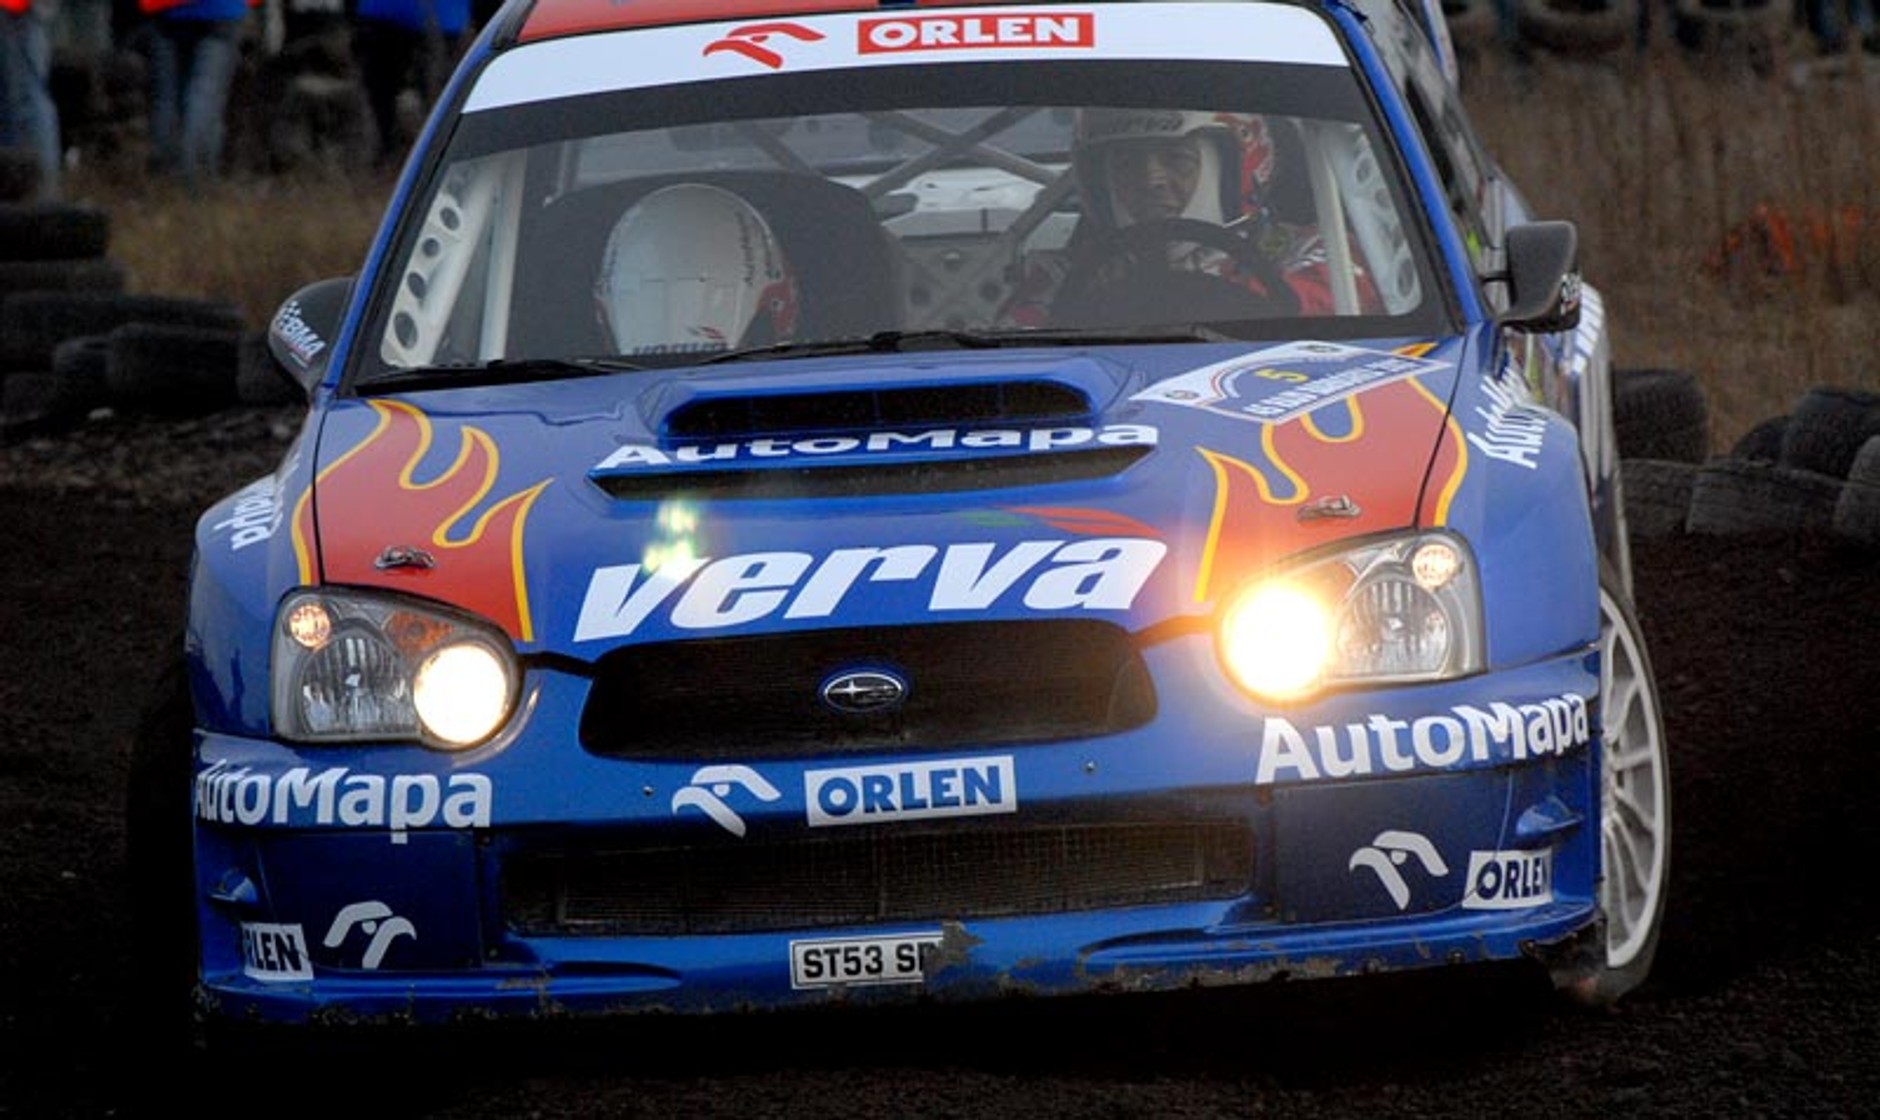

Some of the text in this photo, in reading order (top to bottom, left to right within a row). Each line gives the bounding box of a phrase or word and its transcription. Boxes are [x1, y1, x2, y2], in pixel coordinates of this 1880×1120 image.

[869, 17, 1080, 48] ORLEN
[1254, 367, 1309, 384] 5
[595, 423, 1160, 470] AutoMapa
[573, 536, 1168, 643] verva
[1255, 694, 1590, 785] AutoMapa
[817, 764, 1001, 817] ORLEN
[802, 944, 884, 979] ST53
